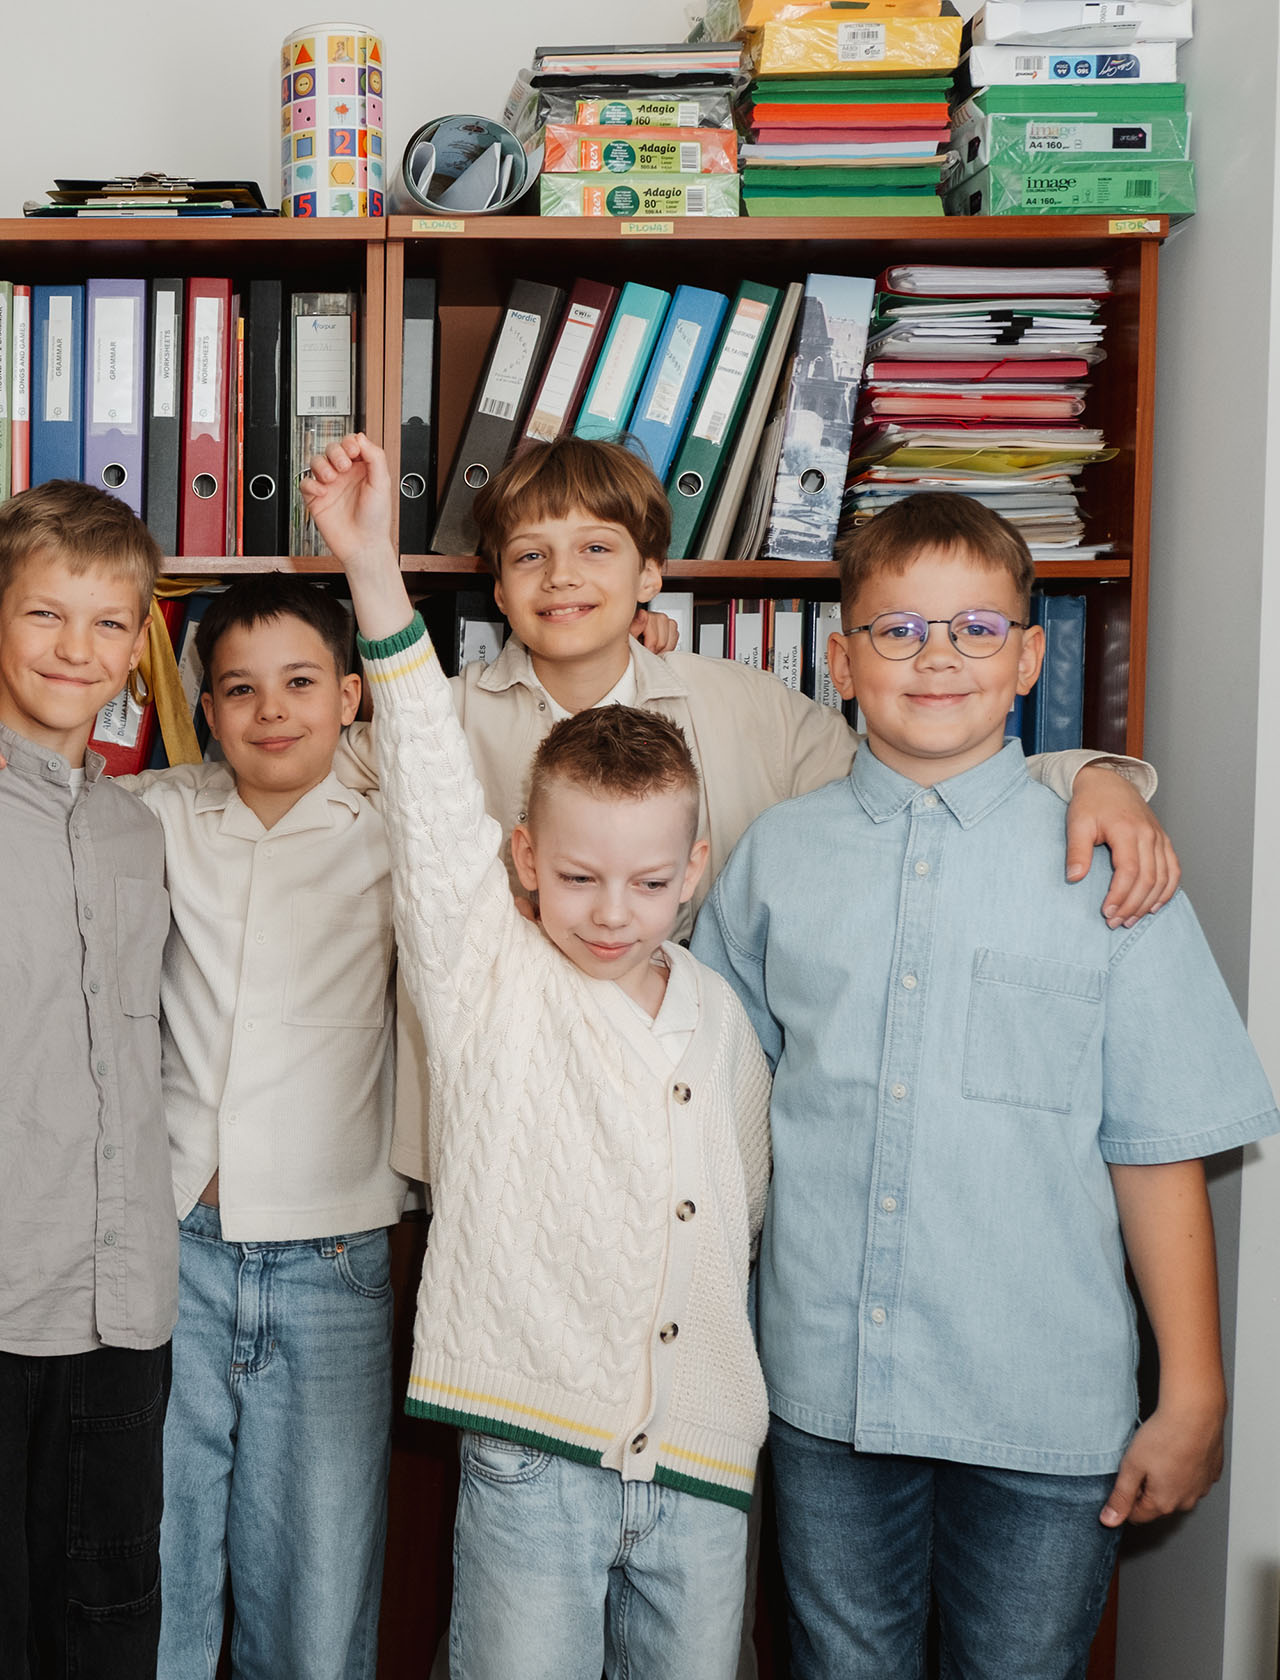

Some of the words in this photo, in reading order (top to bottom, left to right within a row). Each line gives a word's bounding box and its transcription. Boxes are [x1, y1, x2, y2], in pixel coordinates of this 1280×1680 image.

[637, 105, 675, 115] Adagio
[635, 116, 651, 126] 160
[1030, 125, 1077, 139] image
[335, 131, 351, 154] 2
[638, 144, 677, 155] Adagio
[1046, 142, 1062, 150] 160
[640, 155, 652, 163] 80
[1026, 177, 1077, 192] image
[642, 188, 682, 198] Adagio
[299, 194, 311, 217] 5
[373, 192, 381, 216] 5
[644, 200, 657, 208] 80
[510, 310, 539, 324] Nordic
[18, 322, 27, 350] GAMES
[17, 350, 26, 366] AND
[54, 337, 64, 378] GRAMMAR
[109, 341, 118, 381] GRAMMAR
[162, 329, 172, 380] WORKSHEETS
[201, 335, 210, 385] WORKSHEETS
[16, 366, 26, 395] SONGS
[792, 645, 801, 667] KNYGA
